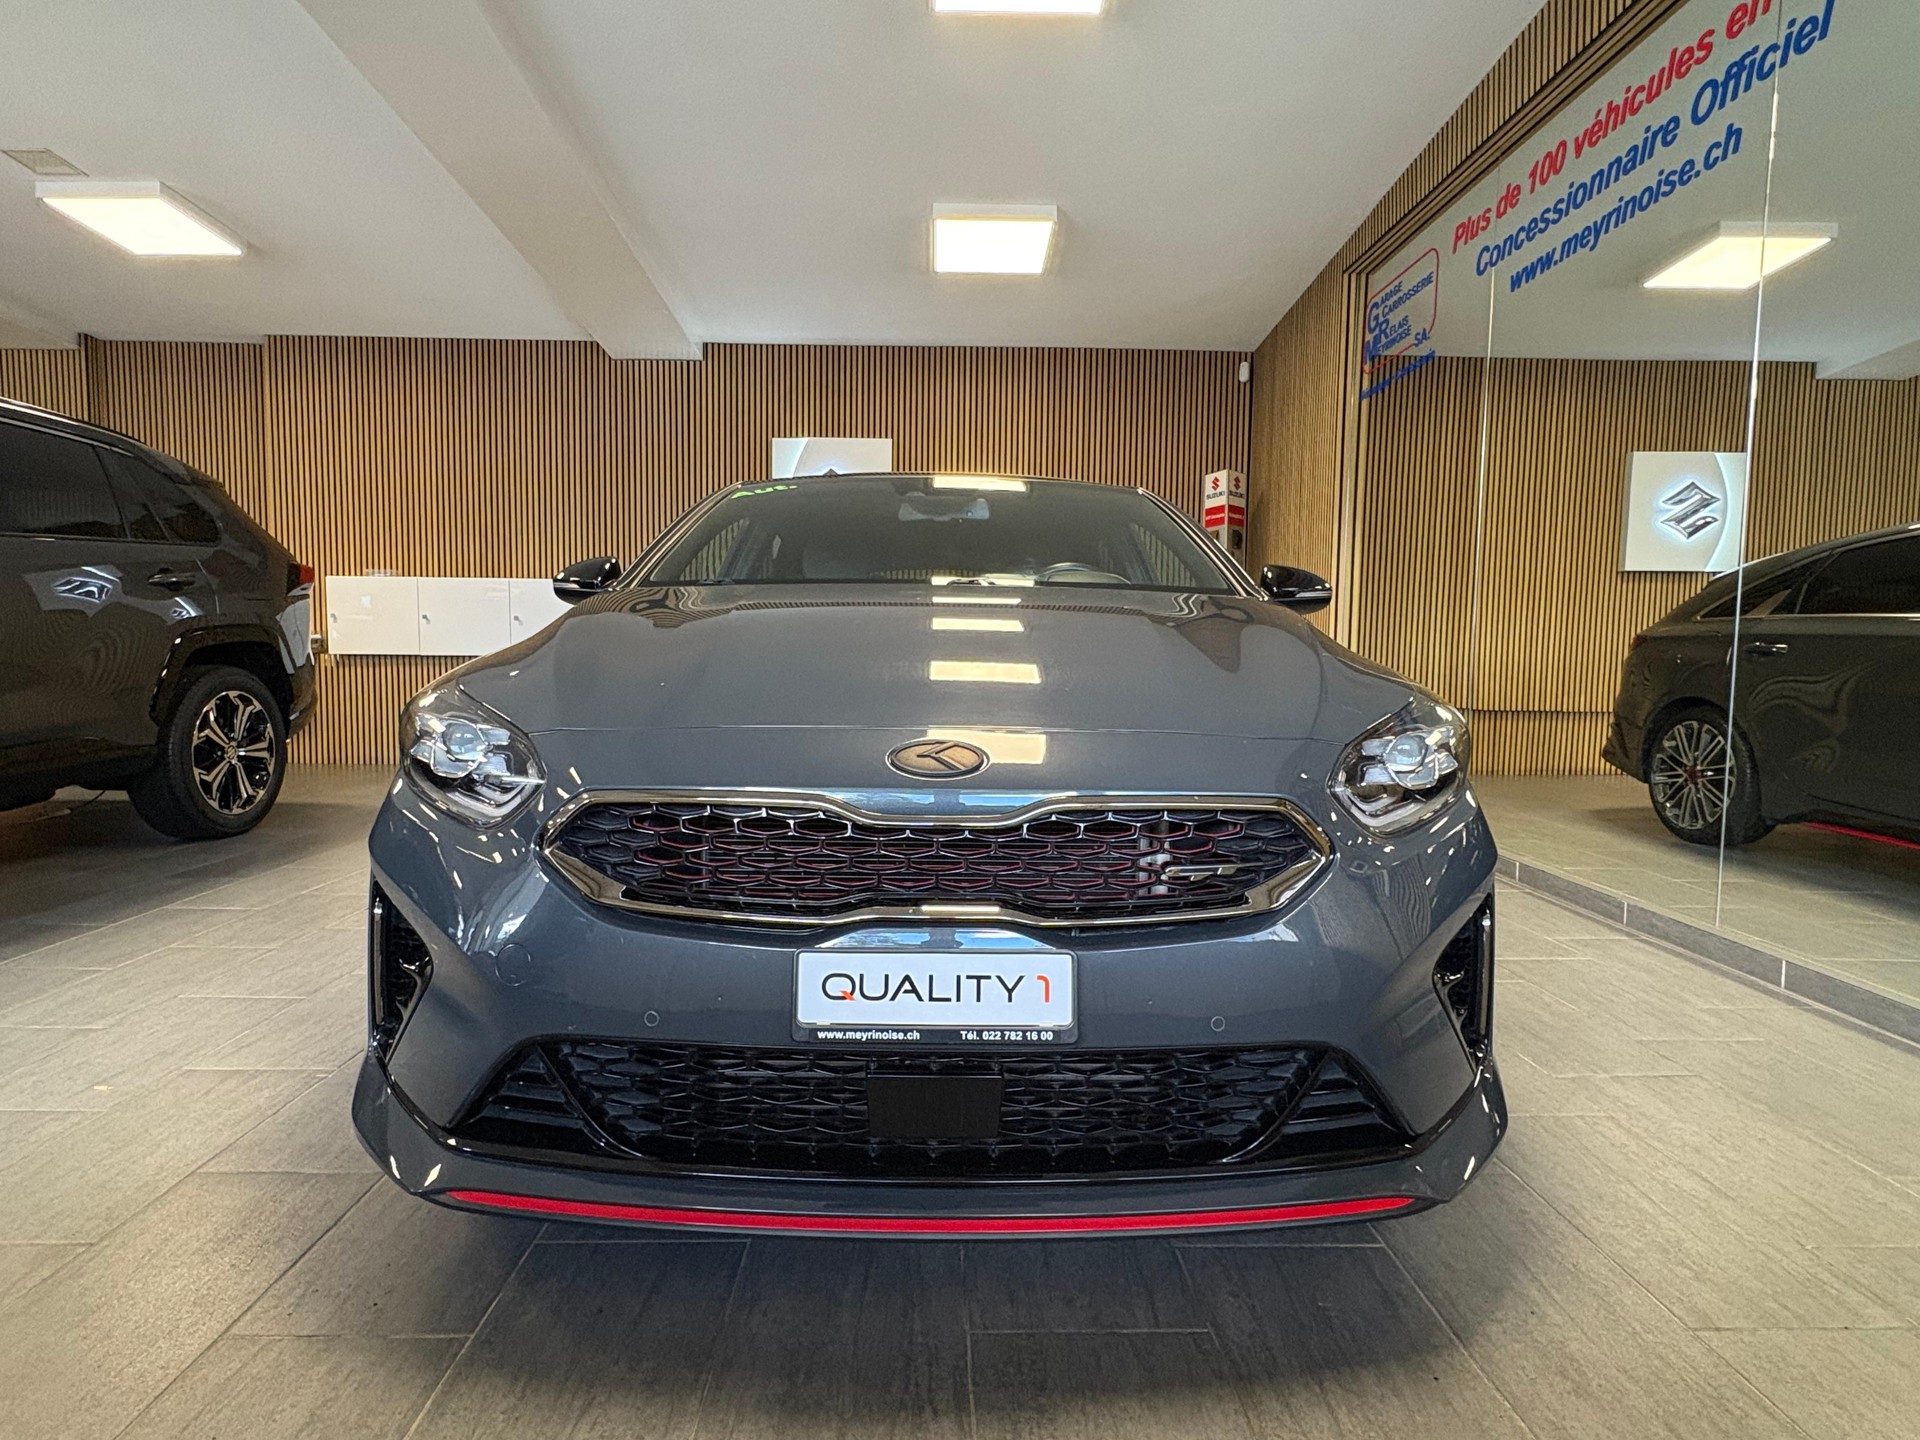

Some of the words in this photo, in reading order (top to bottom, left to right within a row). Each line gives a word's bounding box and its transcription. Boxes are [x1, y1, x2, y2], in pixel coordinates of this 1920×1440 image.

[1452, 206, 1493, 254] Plus
[1495, 182, 1522, 220] de
[1528, 138, 1568, 194] 100
[1573, 28, 1715, 159] véhicules
[1725, 0, 1772, 40] en
[1475, 113, 1681, 277] Concessionnaire
[1690, 0, 1836, 127] Officiel
[1509, 122, 1743, 293] www.meyrinoise.ch
[816, 1029, 921, 1042] www.meyrinoise.ch
[821, 972, 1026, 1003] QUALITY
[1036, 974, 1051, 1003] 1
[959, 1029, 980, 1041] Tél.
[981, 1030, 1002, 1041] 022
[1003, 1030, 1024, 1041] 782
[1025, 1030, 1039, 1041] 16
[1039, 1030, 1054, 1041] 00
